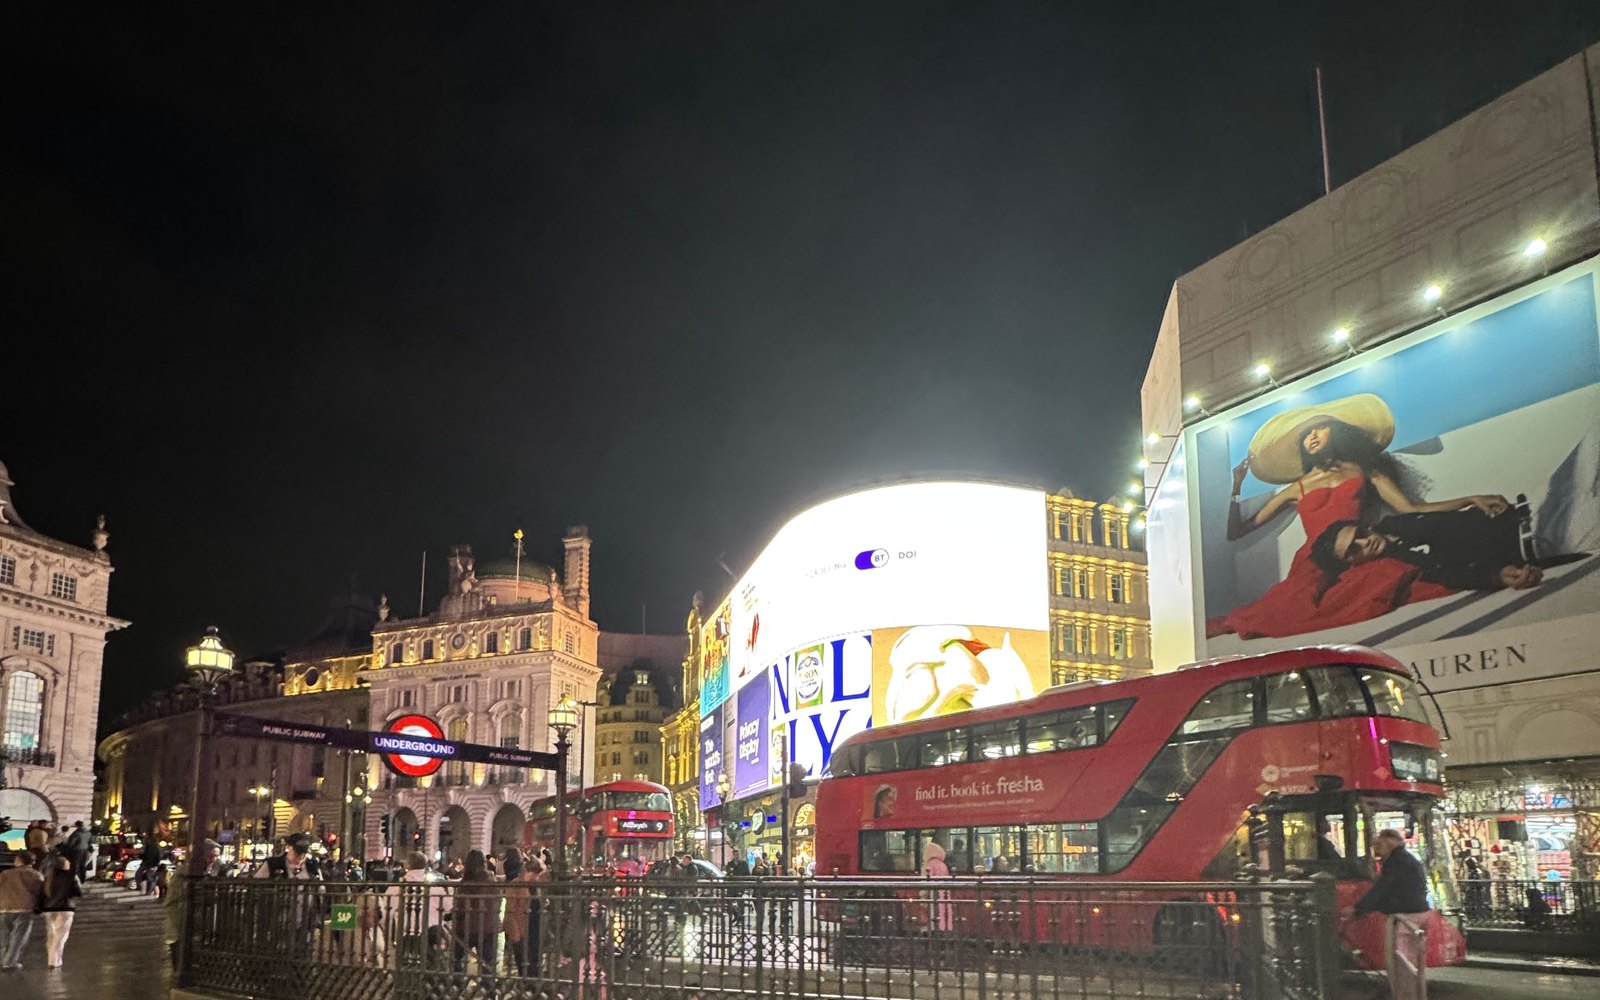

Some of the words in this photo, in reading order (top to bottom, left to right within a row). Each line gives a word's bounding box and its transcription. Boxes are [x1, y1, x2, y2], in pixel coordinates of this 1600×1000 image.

[874, 554, 885, 562] BT
[262, 725, 291, 736] PUBLIC
[293, 729, 326, 739] SUBWAY
[374, 737, 455, 755] UNDERGROUND
[739, 738, 760, 761] Display
[489, 752, 508, 760] PUBLIC
[510, 754, 532, 762] SUBWAY
[915, 786, 935, 800] find
[937, 785, 949, 799] it.
[950, 783, 980, 797] book
[981, 781, 995, 795] it.
[996, 775, 1045, 794] fresha
[656, 822, 663, 831] 9
